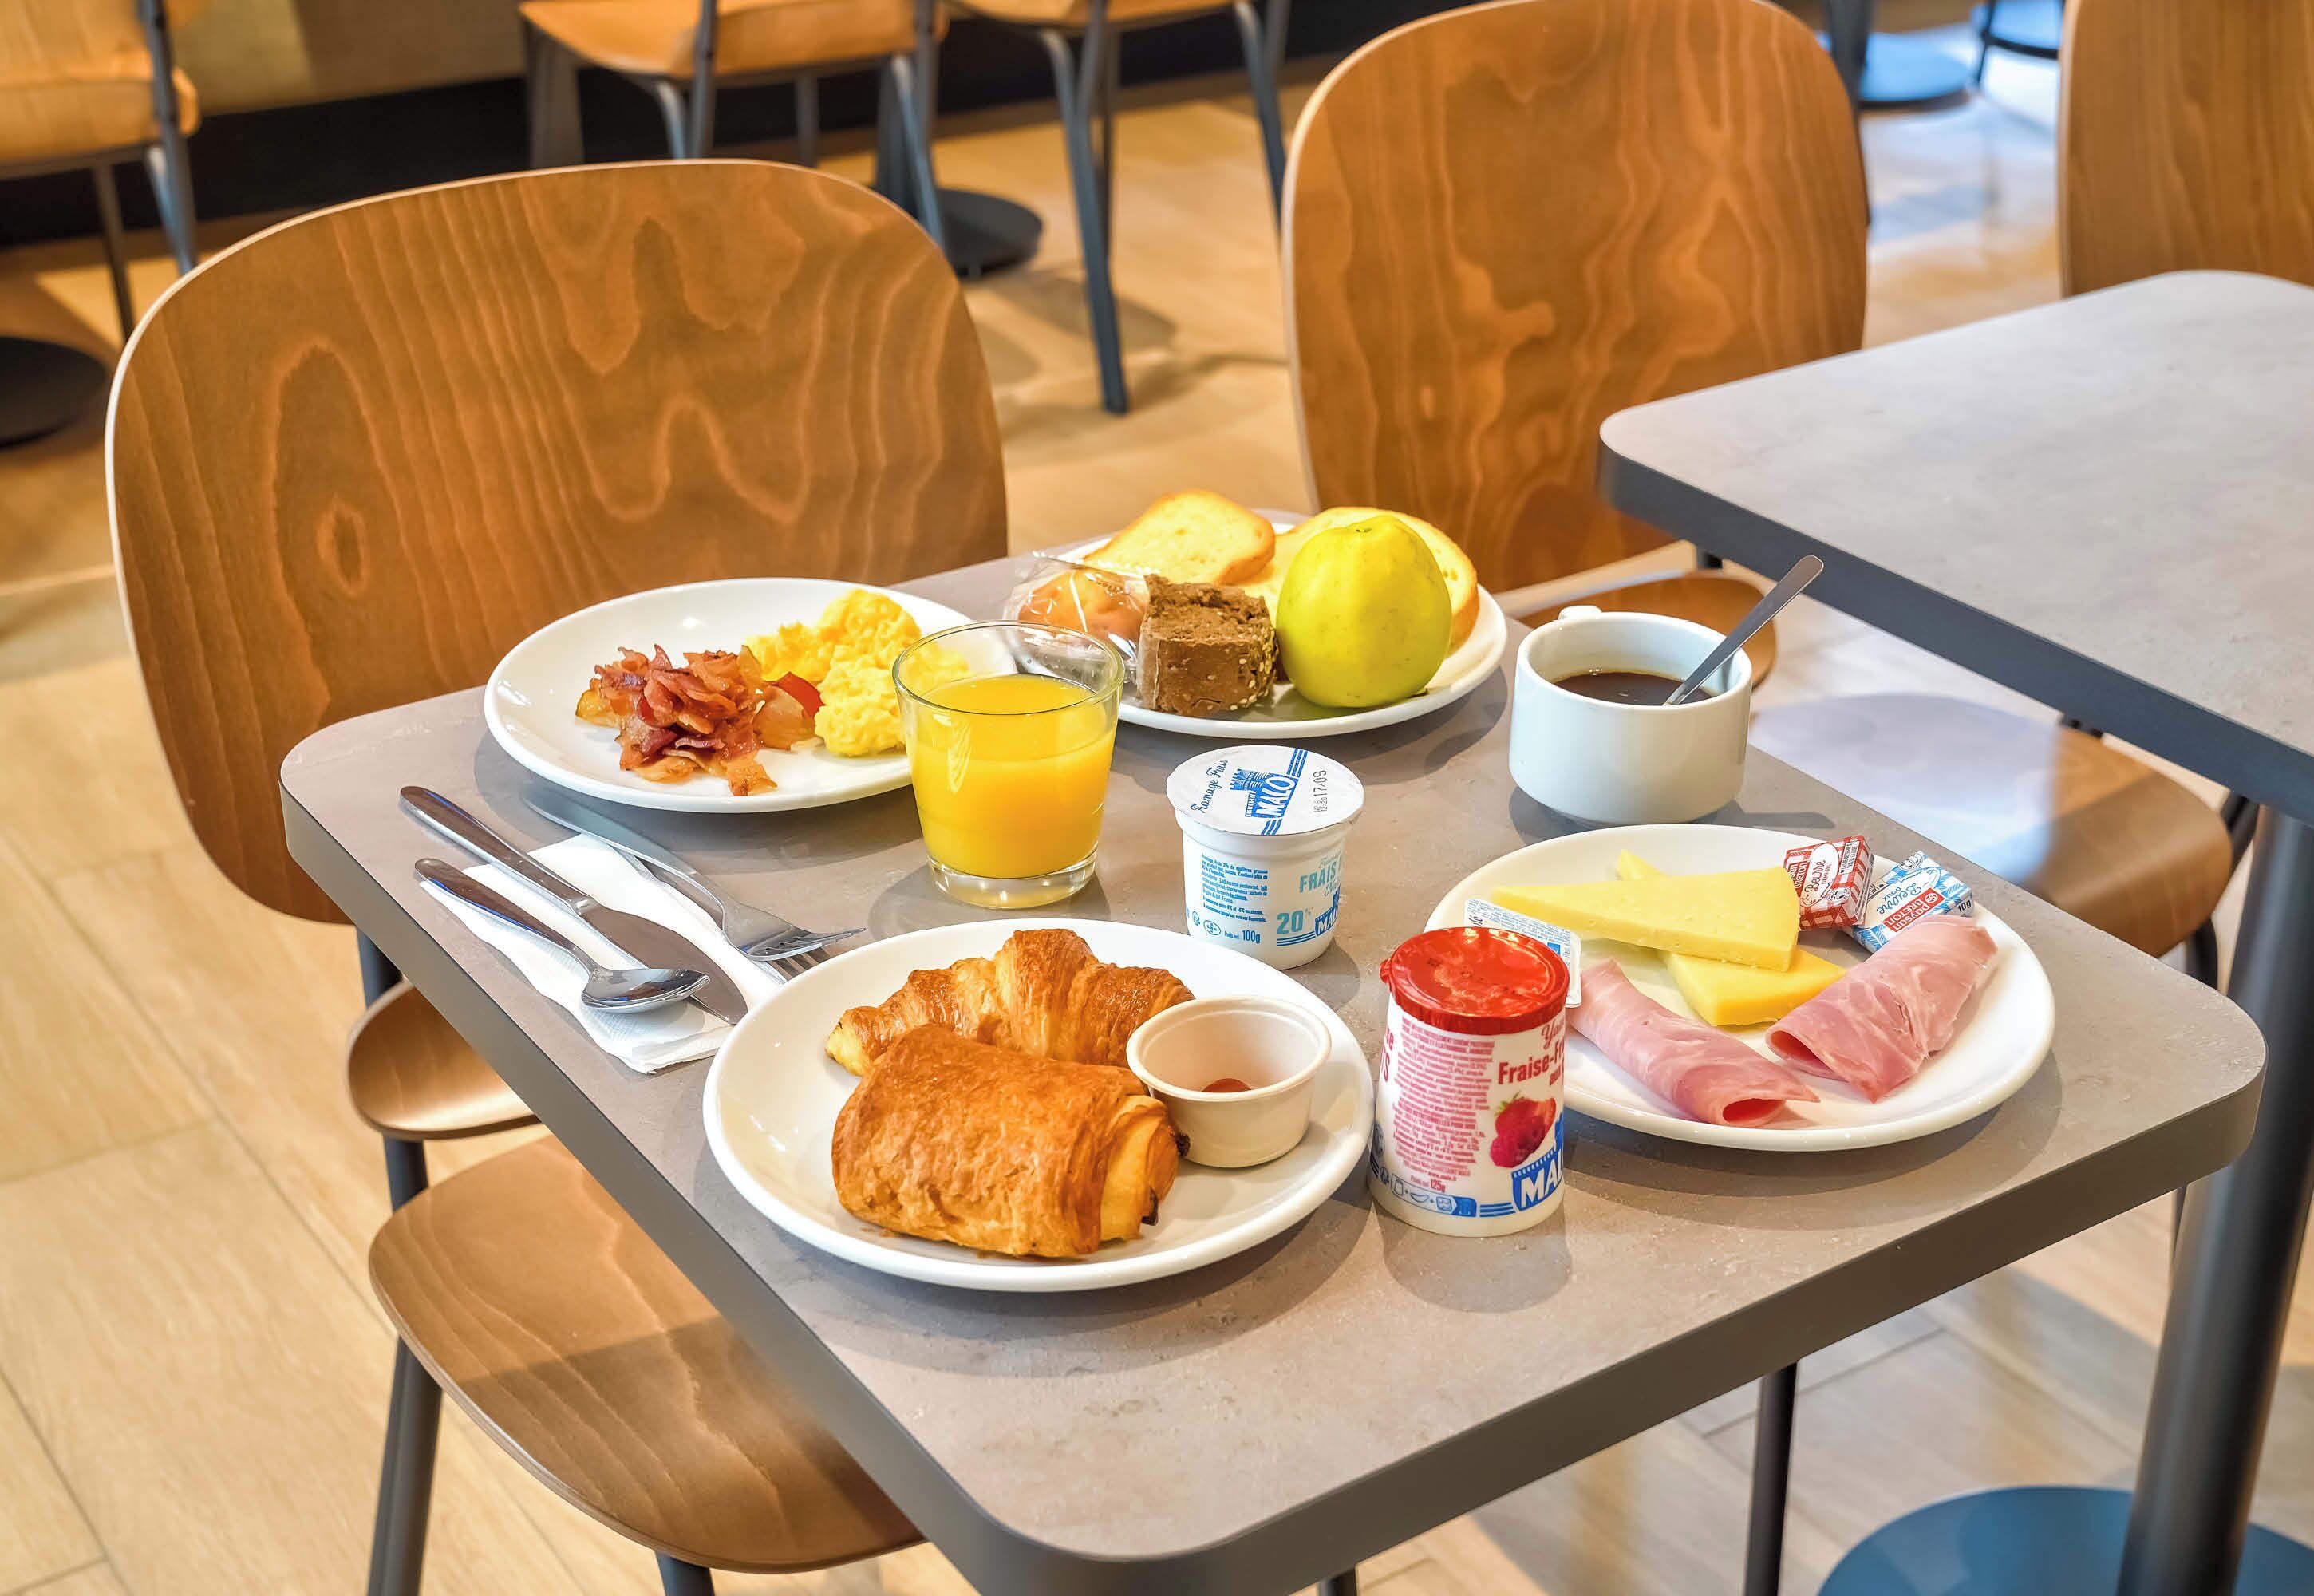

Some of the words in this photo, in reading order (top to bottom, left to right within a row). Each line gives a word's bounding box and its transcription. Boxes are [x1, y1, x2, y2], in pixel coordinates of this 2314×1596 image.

[1206, 760, 1228, 778] Frais
[1313, 770, 1327, 796] 17/09
[1191, 780, 1222, 813] Fromage
[1255, 776, 1296, 816] MALO
[1299, 862, 1337, 893] FRAIS
[1804, 859, 1826, 892] Beurre
[1877, 883, 1921, 915] Beurre
[1883, 887, 1901, 901] DOUX
[1958, 899, 1972, 913] 10g
[1317, 904, 1339, 934] MAL
[1891, 903, 1930, 930] paysan
[1242, 930, 1261, 944] 100g
[1430, 1179, 1446, 1194] 125g
[1520, 1149, 1563, 1208] MAL
